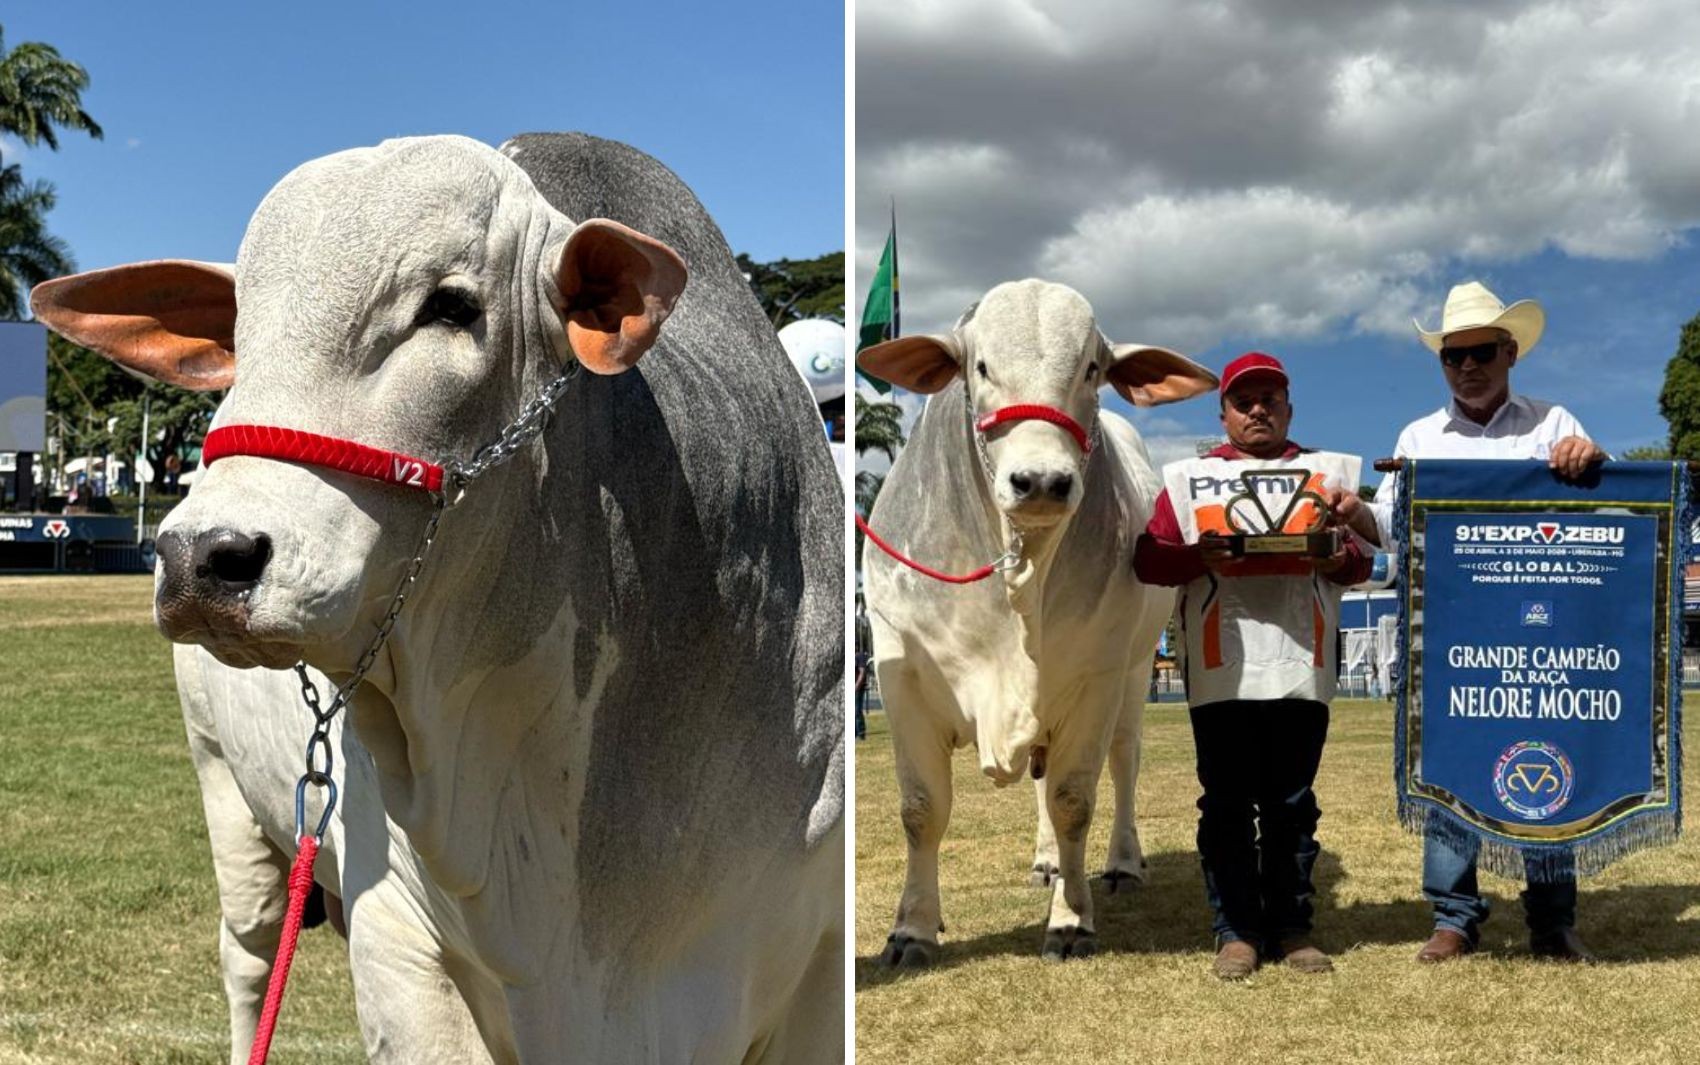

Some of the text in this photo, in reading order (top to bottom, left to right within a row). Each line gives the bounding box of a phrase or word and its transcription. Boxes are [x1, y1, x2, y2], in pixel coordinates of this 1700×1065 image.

[394, 458, 424, 486] V2
[1503, 561, 1576, 573] GLOBAL
[1472, 574, 1604, 585] PORQUE É FEITA POR TODOS.
[1448, 644, 1620, 671] GRANDE CAMPEÃO
[1501, 670, 1570, 688] DA RAÇA
[1449, 686, 1622, 721] NELORE MOCHO
